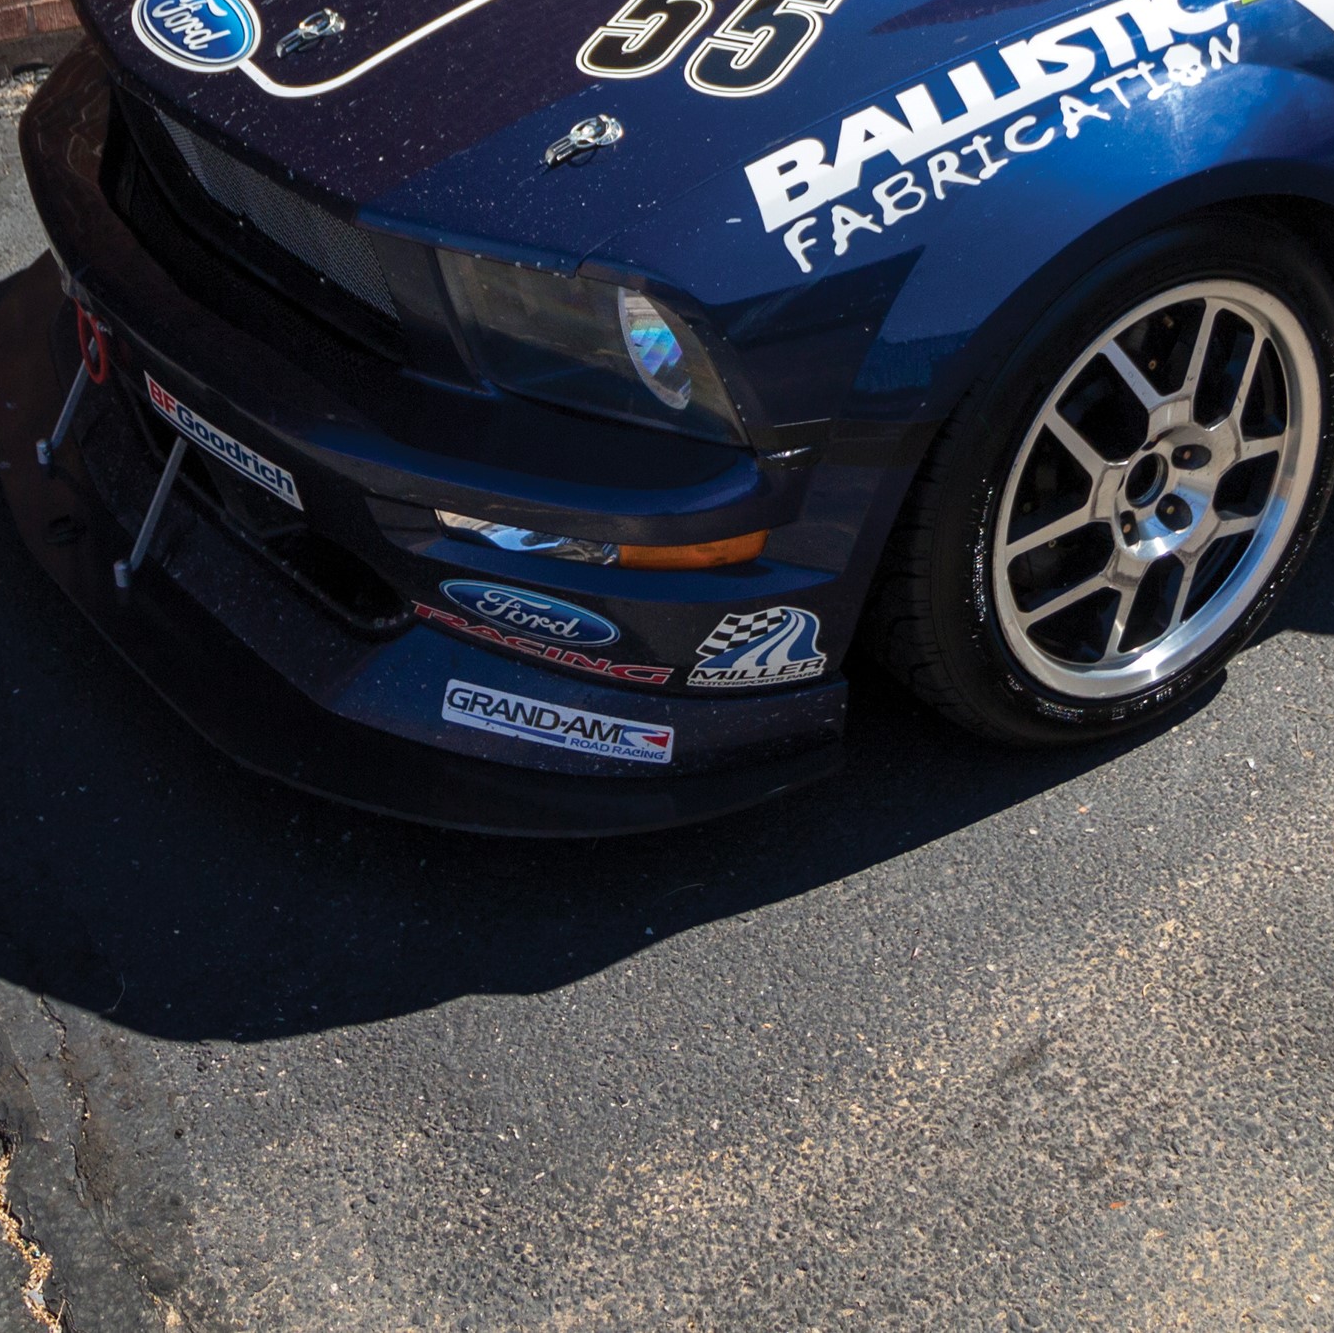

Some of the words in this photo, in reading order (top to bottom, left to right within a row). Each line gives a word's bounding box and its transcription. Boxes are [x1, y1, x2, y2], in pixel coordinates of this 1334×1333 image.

[148, 378, 294, 496] BFGoodrich
[476, 589, 580, 639] Ford
[411, 600, 674, 684] RACING
[688, 676, 785, 686] MOTORSPORTS
[785, 670, 821, 681] PARK
[690, 657, 826, 680] MILLER
[570, 737, 610, 754] ROAD
[611, 745, 665, 761] RACING
